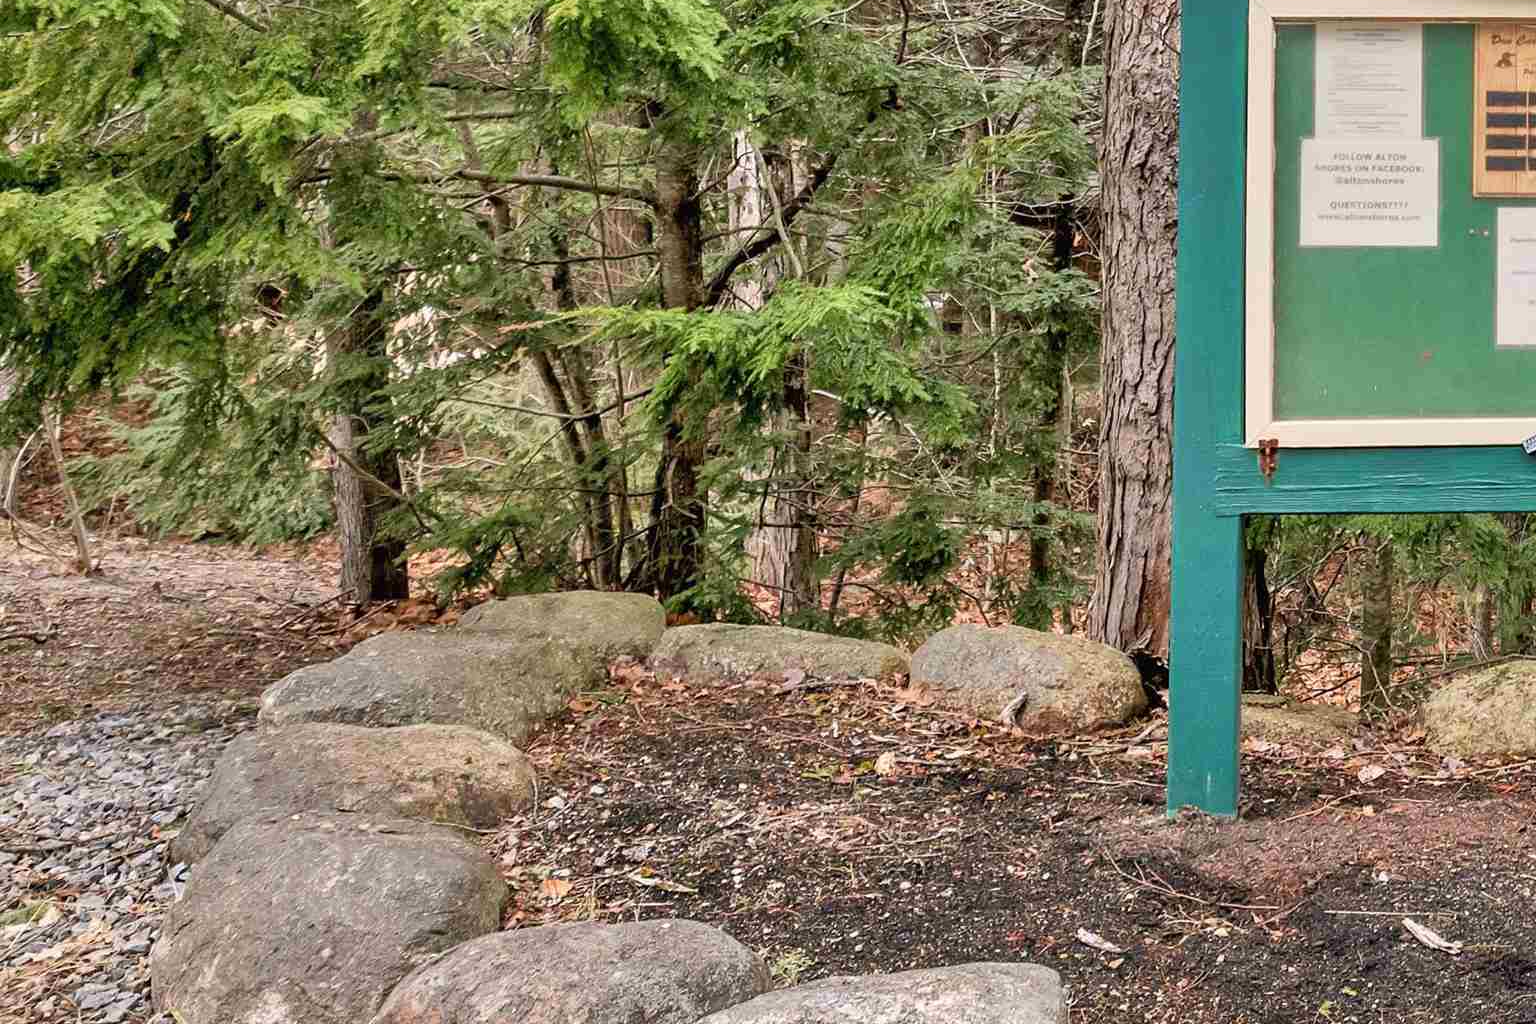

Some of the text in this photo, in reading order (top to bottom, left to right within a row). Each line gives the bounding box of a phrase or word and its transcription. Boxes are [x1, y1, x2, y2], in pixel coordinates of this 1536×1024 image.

[1333, 153, 1408, 162] FOLLOW ALTON
[1354, 164, 1369, 173] ON
